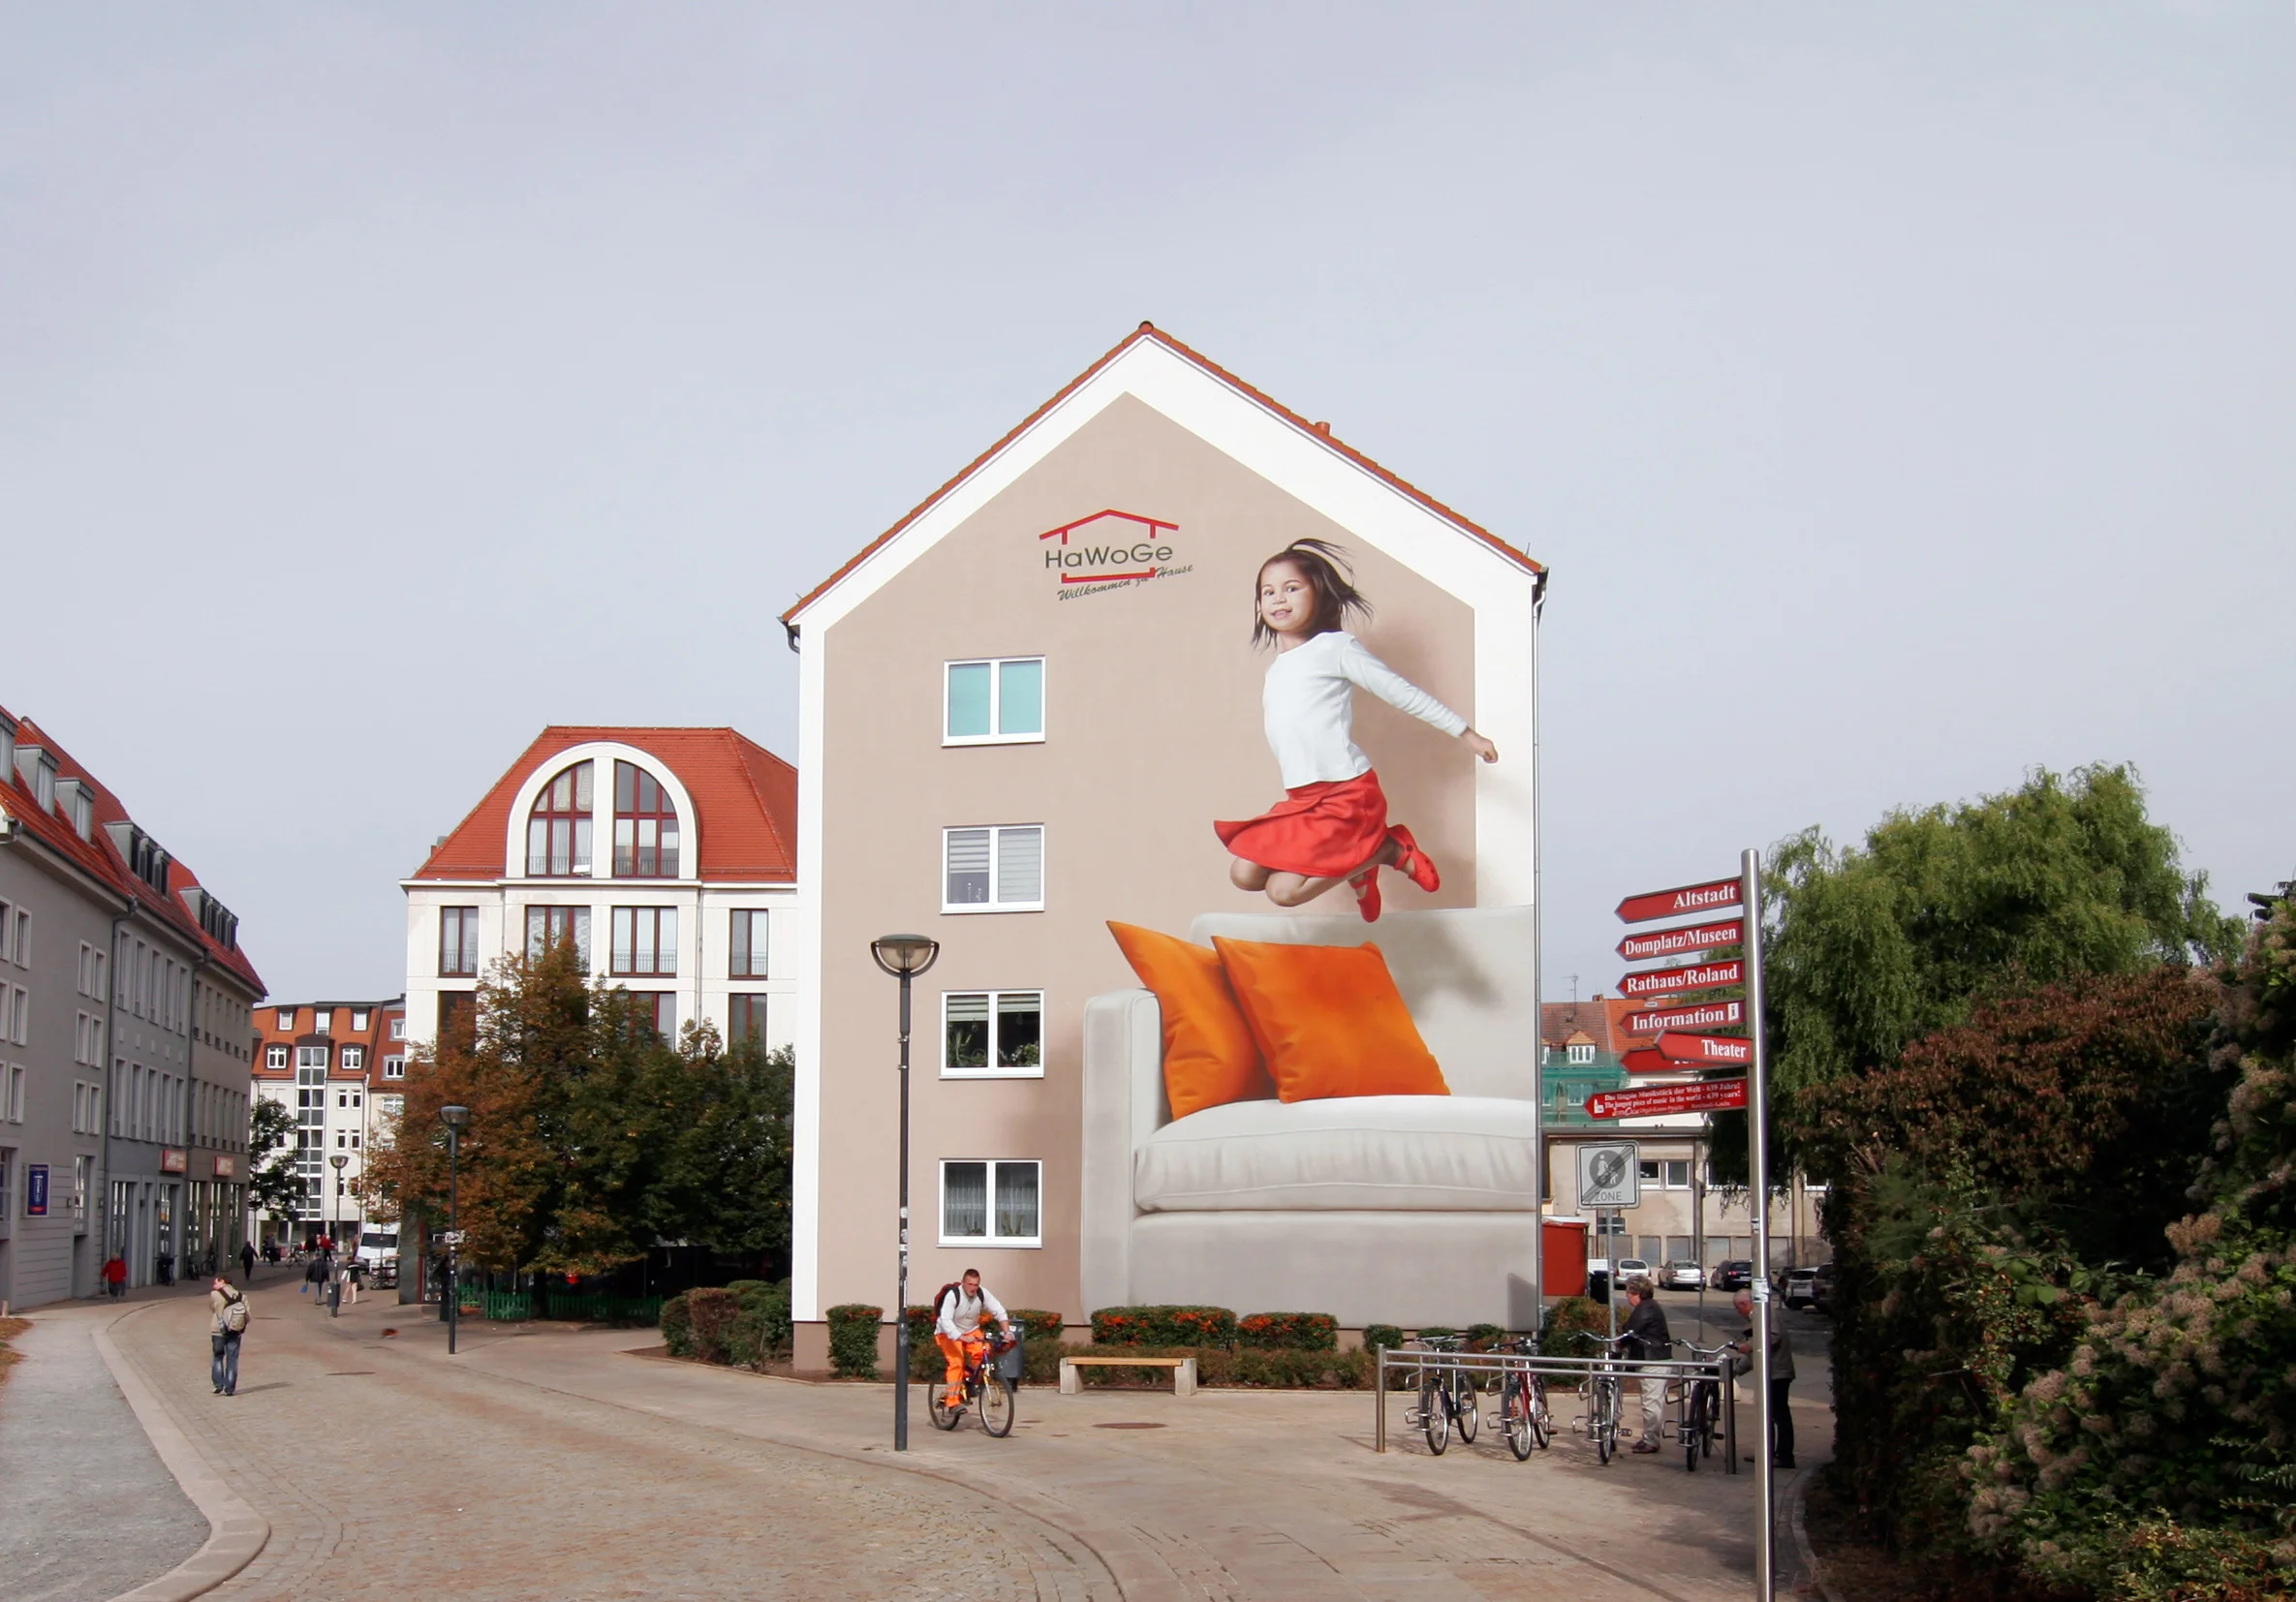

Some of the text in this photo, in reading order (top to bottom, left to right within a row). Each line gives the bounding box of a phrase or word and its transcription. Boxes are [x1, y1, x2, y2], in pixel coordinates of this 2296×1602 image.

[1045, 543, 1173, 569] HaWoGe
[1057, 578, 1132, 601] Willkommen
[1155, 565, 1194, 579] Hause
[1673, 885, 1735, 909] Altstadt
[1626, 928, 1736, 955] Domplatz/Museen
[1627, 964, 1738, 993] Rathaus/Roland
[1632, 1008, 1724, 1031] Information
[1701, 1038, 1746, 1058] Theater
[1595, 1190, 1623, 1201] ZONE
